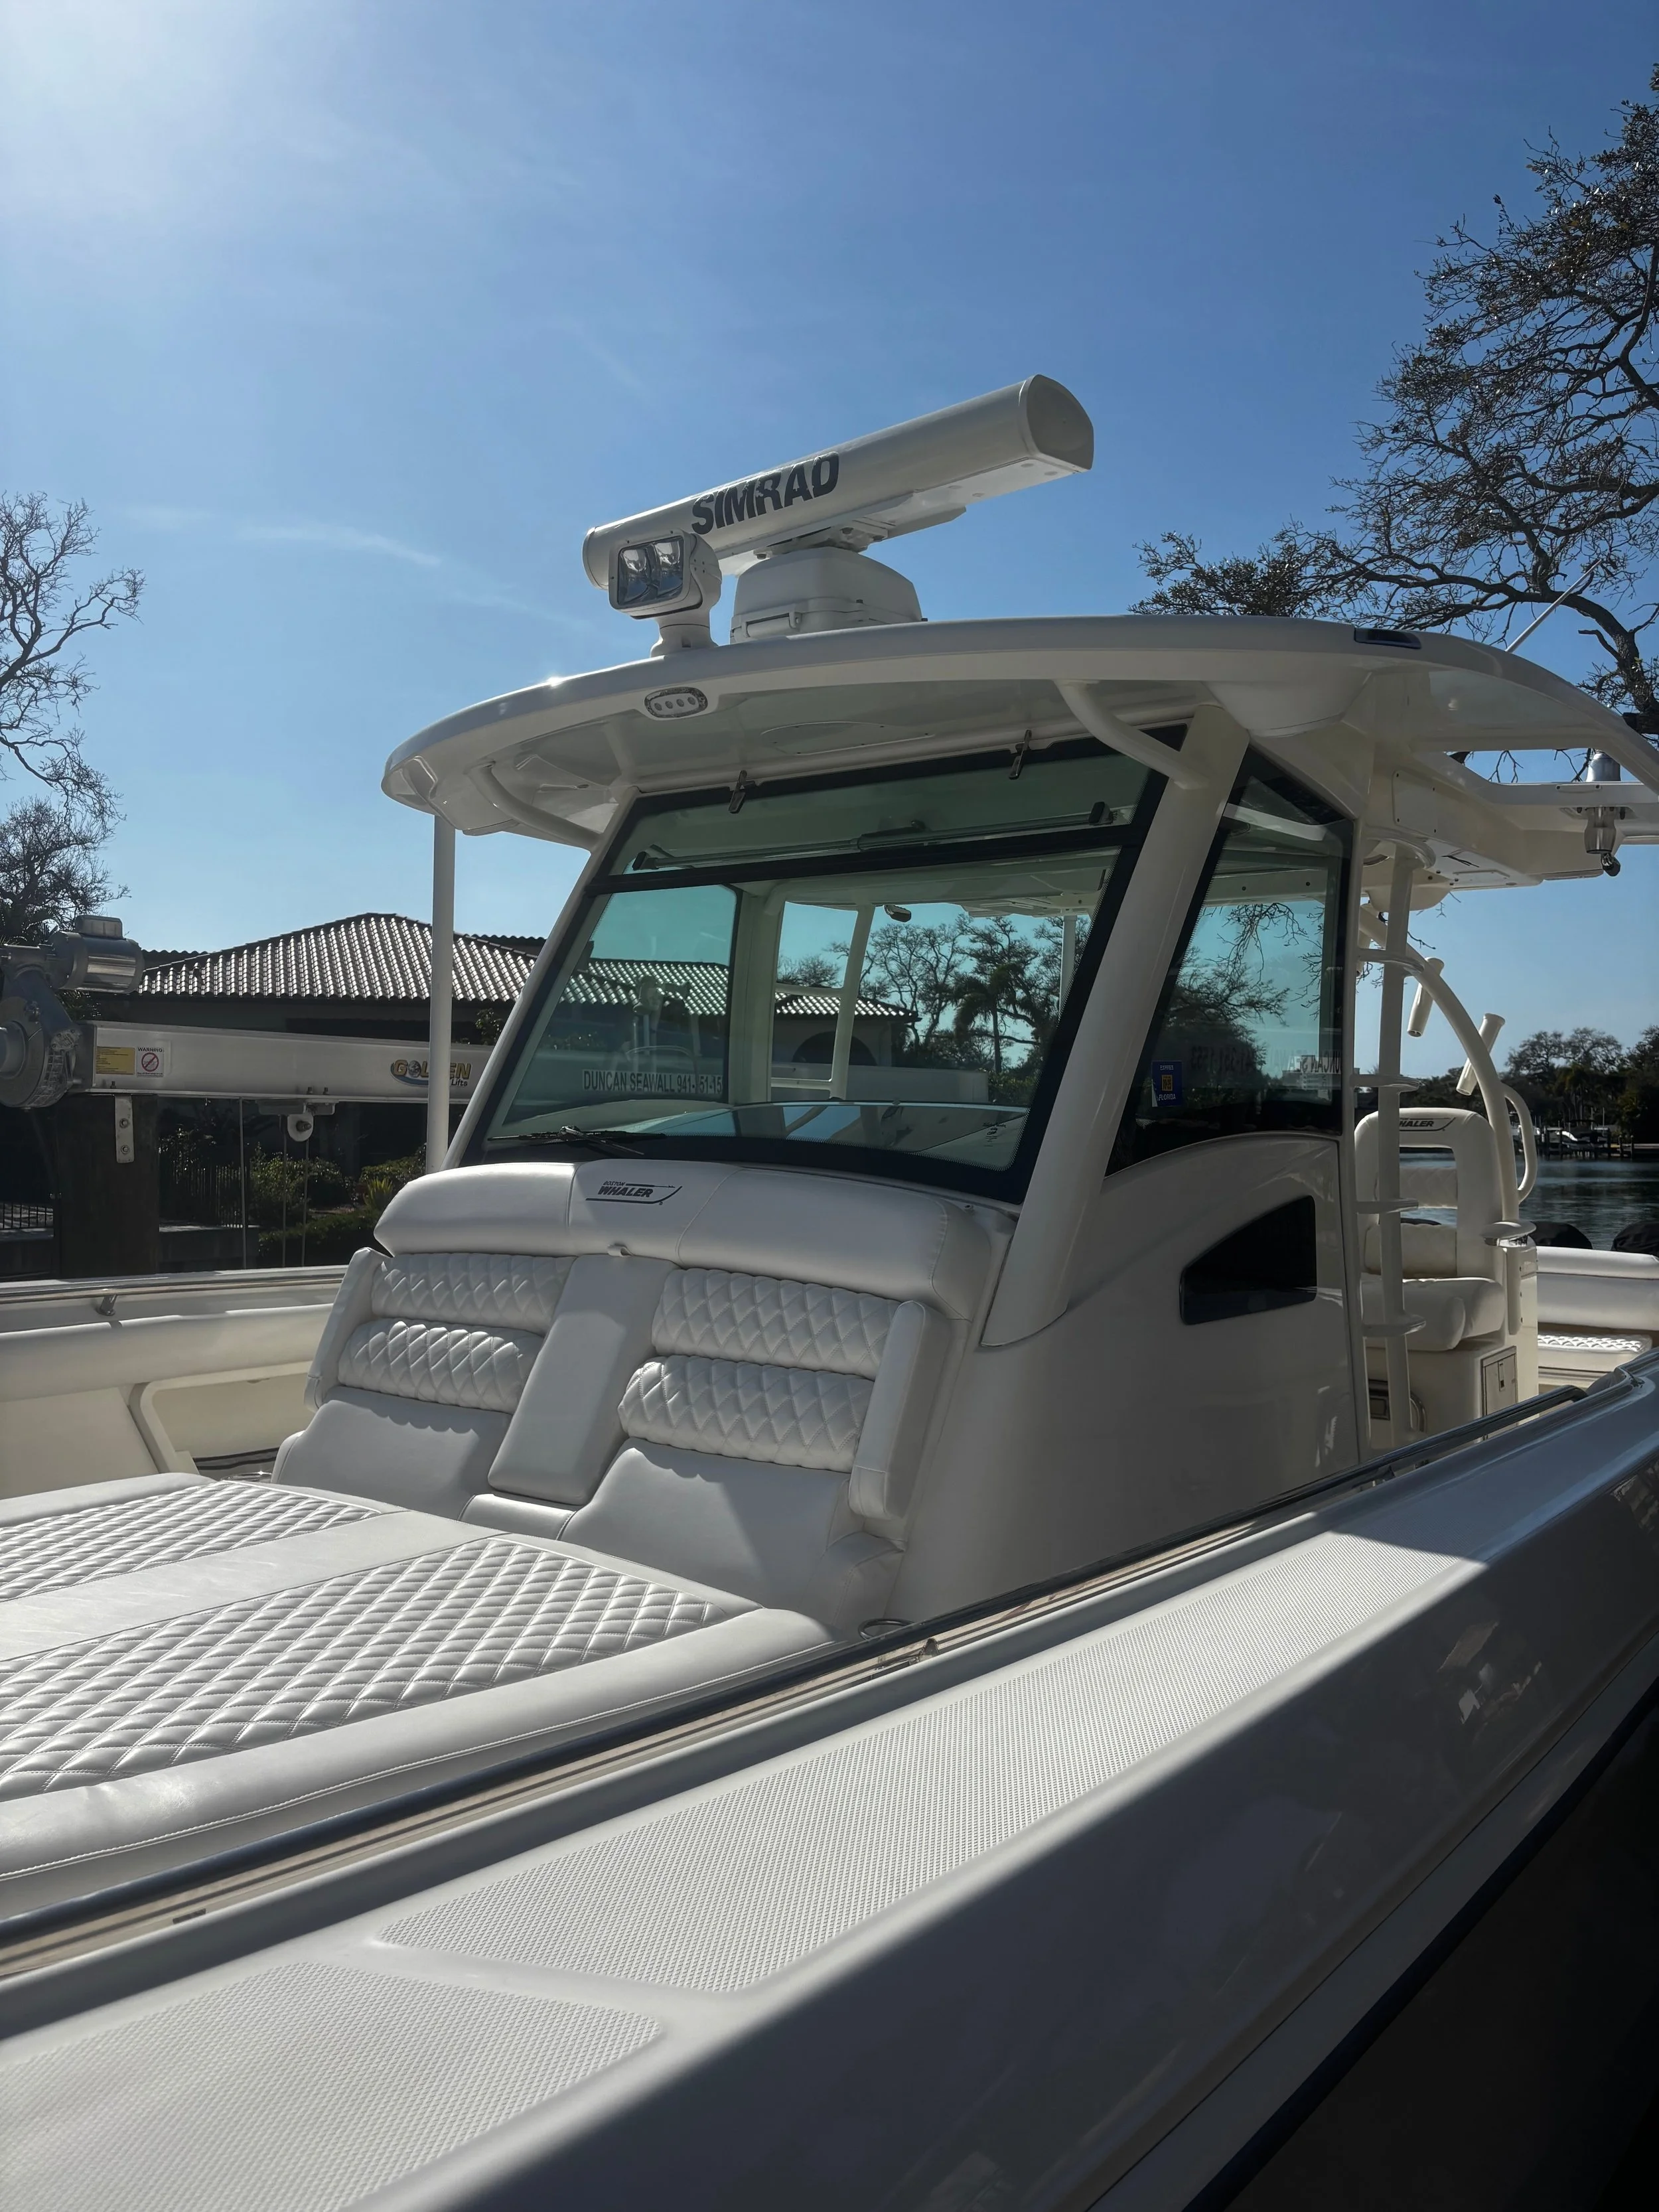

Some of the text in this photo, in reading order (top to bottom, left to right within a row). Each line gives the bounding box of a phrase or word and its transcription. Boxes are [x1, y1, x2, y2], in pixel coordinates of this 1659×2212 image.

[691, 452, 839, 535] SIMRAD
[394, 1059, 472, 1080] GOLEN
[583, 1070, 722, 1094] DUNCAN SEAWALL 941-51-15
[598, 1185, 654, 1198] WHALER
